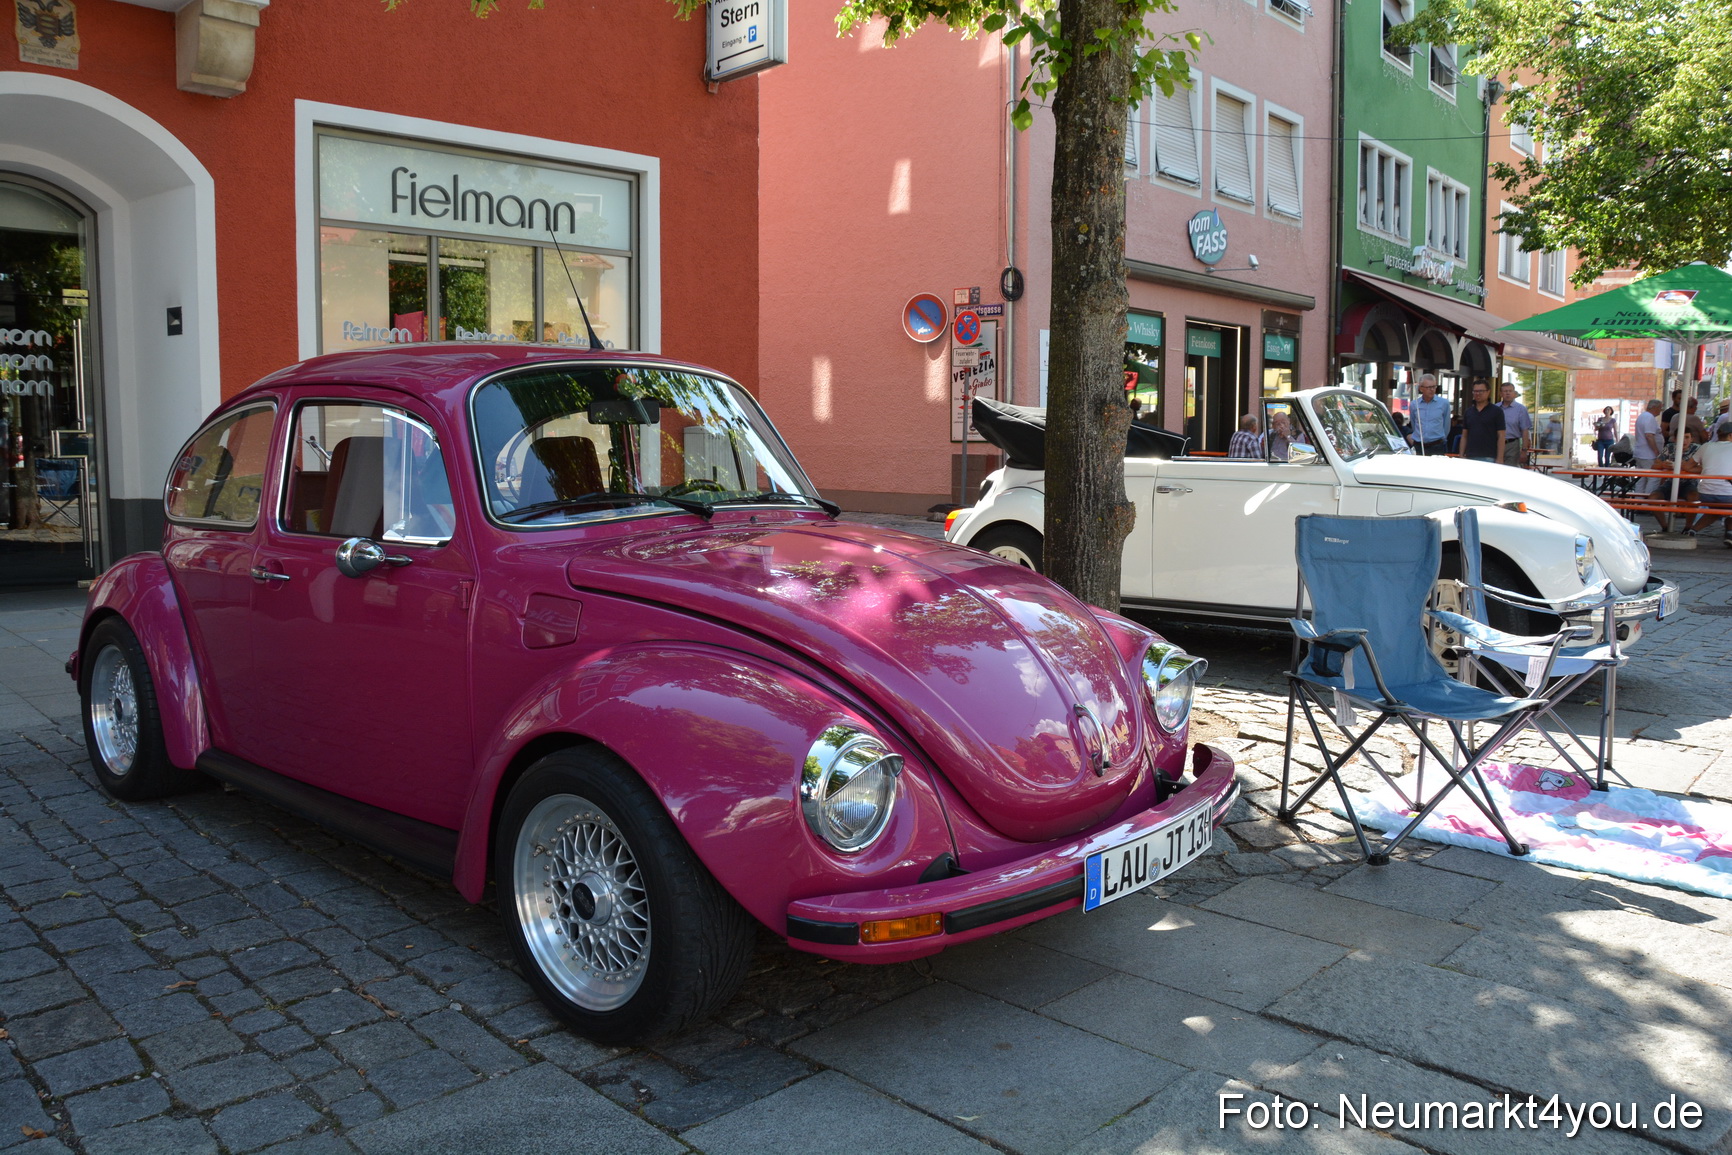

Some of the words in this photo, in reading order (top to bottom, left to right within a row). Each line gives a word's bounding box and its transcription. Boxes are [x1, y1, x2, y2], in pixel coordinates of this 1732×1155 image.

[720, 1, 760, 28] Stern
[721, 35, 742, 48] Eingang
[391, 166, 576, 234] fielmann
[1189, 216, 1210, 235] vom
[1195, 229, 1227, 257] FASS
[1133, 321, 1160, 341] Whisky
[1191, 335, 1217, 350] Feinkost
[1266, 340, 1281, 356] Essig
[1104, 843, 1148, 898] LAU
[1162, 824, 1185, 871] JT
[1187, 806, 1213, 857] 13H
[1090, 888, 1097, 900] D
